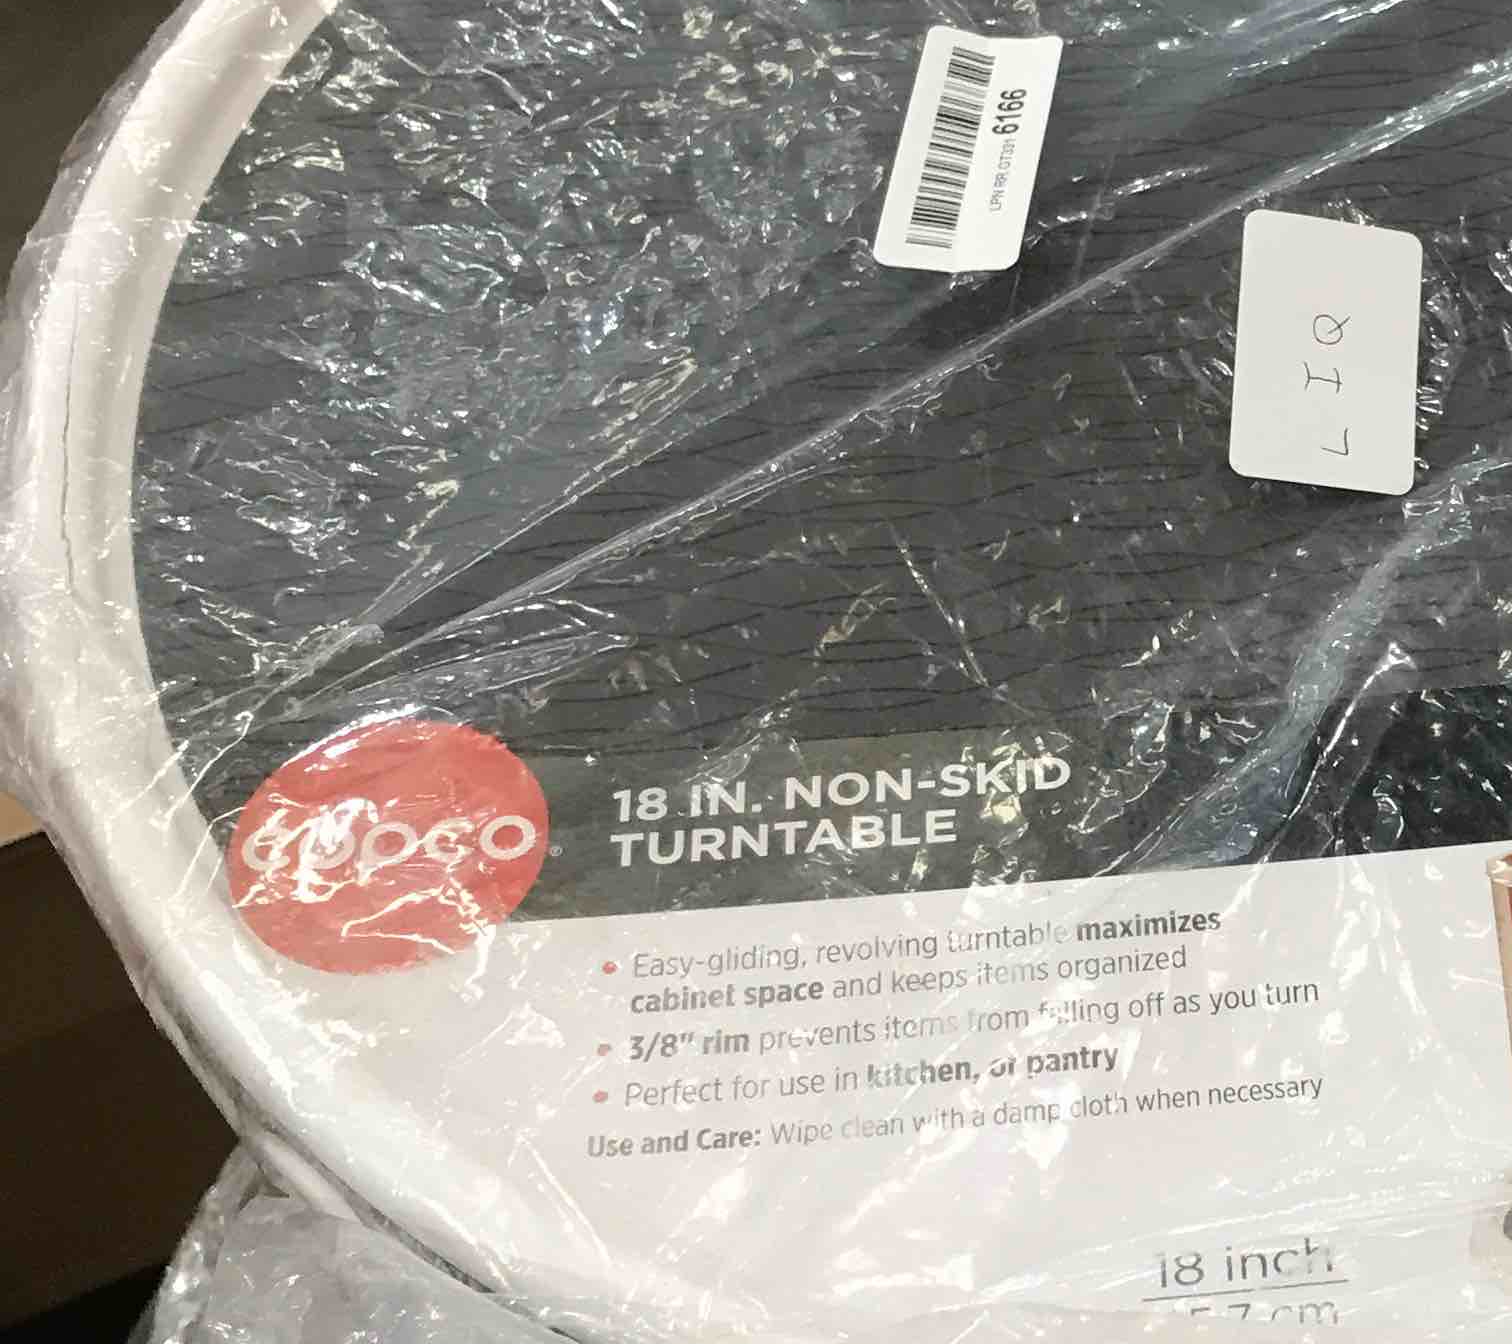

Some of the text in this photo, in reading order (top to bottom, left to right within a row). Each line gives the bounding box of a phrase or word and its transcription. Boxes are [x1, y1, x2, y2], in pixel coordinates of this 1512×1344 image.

[991, 88, 1027, 135] 6166
[989, 187, 1005, 213] LPN
[612, 756, 1072, 823] 18 IN. NON-SKID
[610, 807, 958, 868] TURNTABLE
[633, 909, 1221, 979] Easy-gliding, revolving turntable maximizes
[630, 944, 1187, 1014] cabinet space and keeps items organized
[630, 1030, 695, 1062] 3/8"
[702, 1029, 750, 1055] rim
[760, 1019, 876, 1054] prevents
[884, 1013, 958, 1041] items
[967, 1008, 1029, 1034] from
[1128, 991, 1168, 1018] off
[1173, 992, 1201, 1016] as
[1210, 987, 1256, 1016] you
[1264, 981, 1320, 1006] turn
[625, 1076, 722, 1107] Perfect
[732, 1074, 770, 1101] for
[779, 1073, 825, 1097] use
[834, 1066, 858, 1092] in
[867, 1056, 979, 1089] kitchen,
[1026, 1046, 1119, 1080] pantry
[587, 1075, 1323, 1158] Use and Care: Wipe clean with a damp cloth when necessary
[1159, 1237, 1334, 1288] 18 inch
